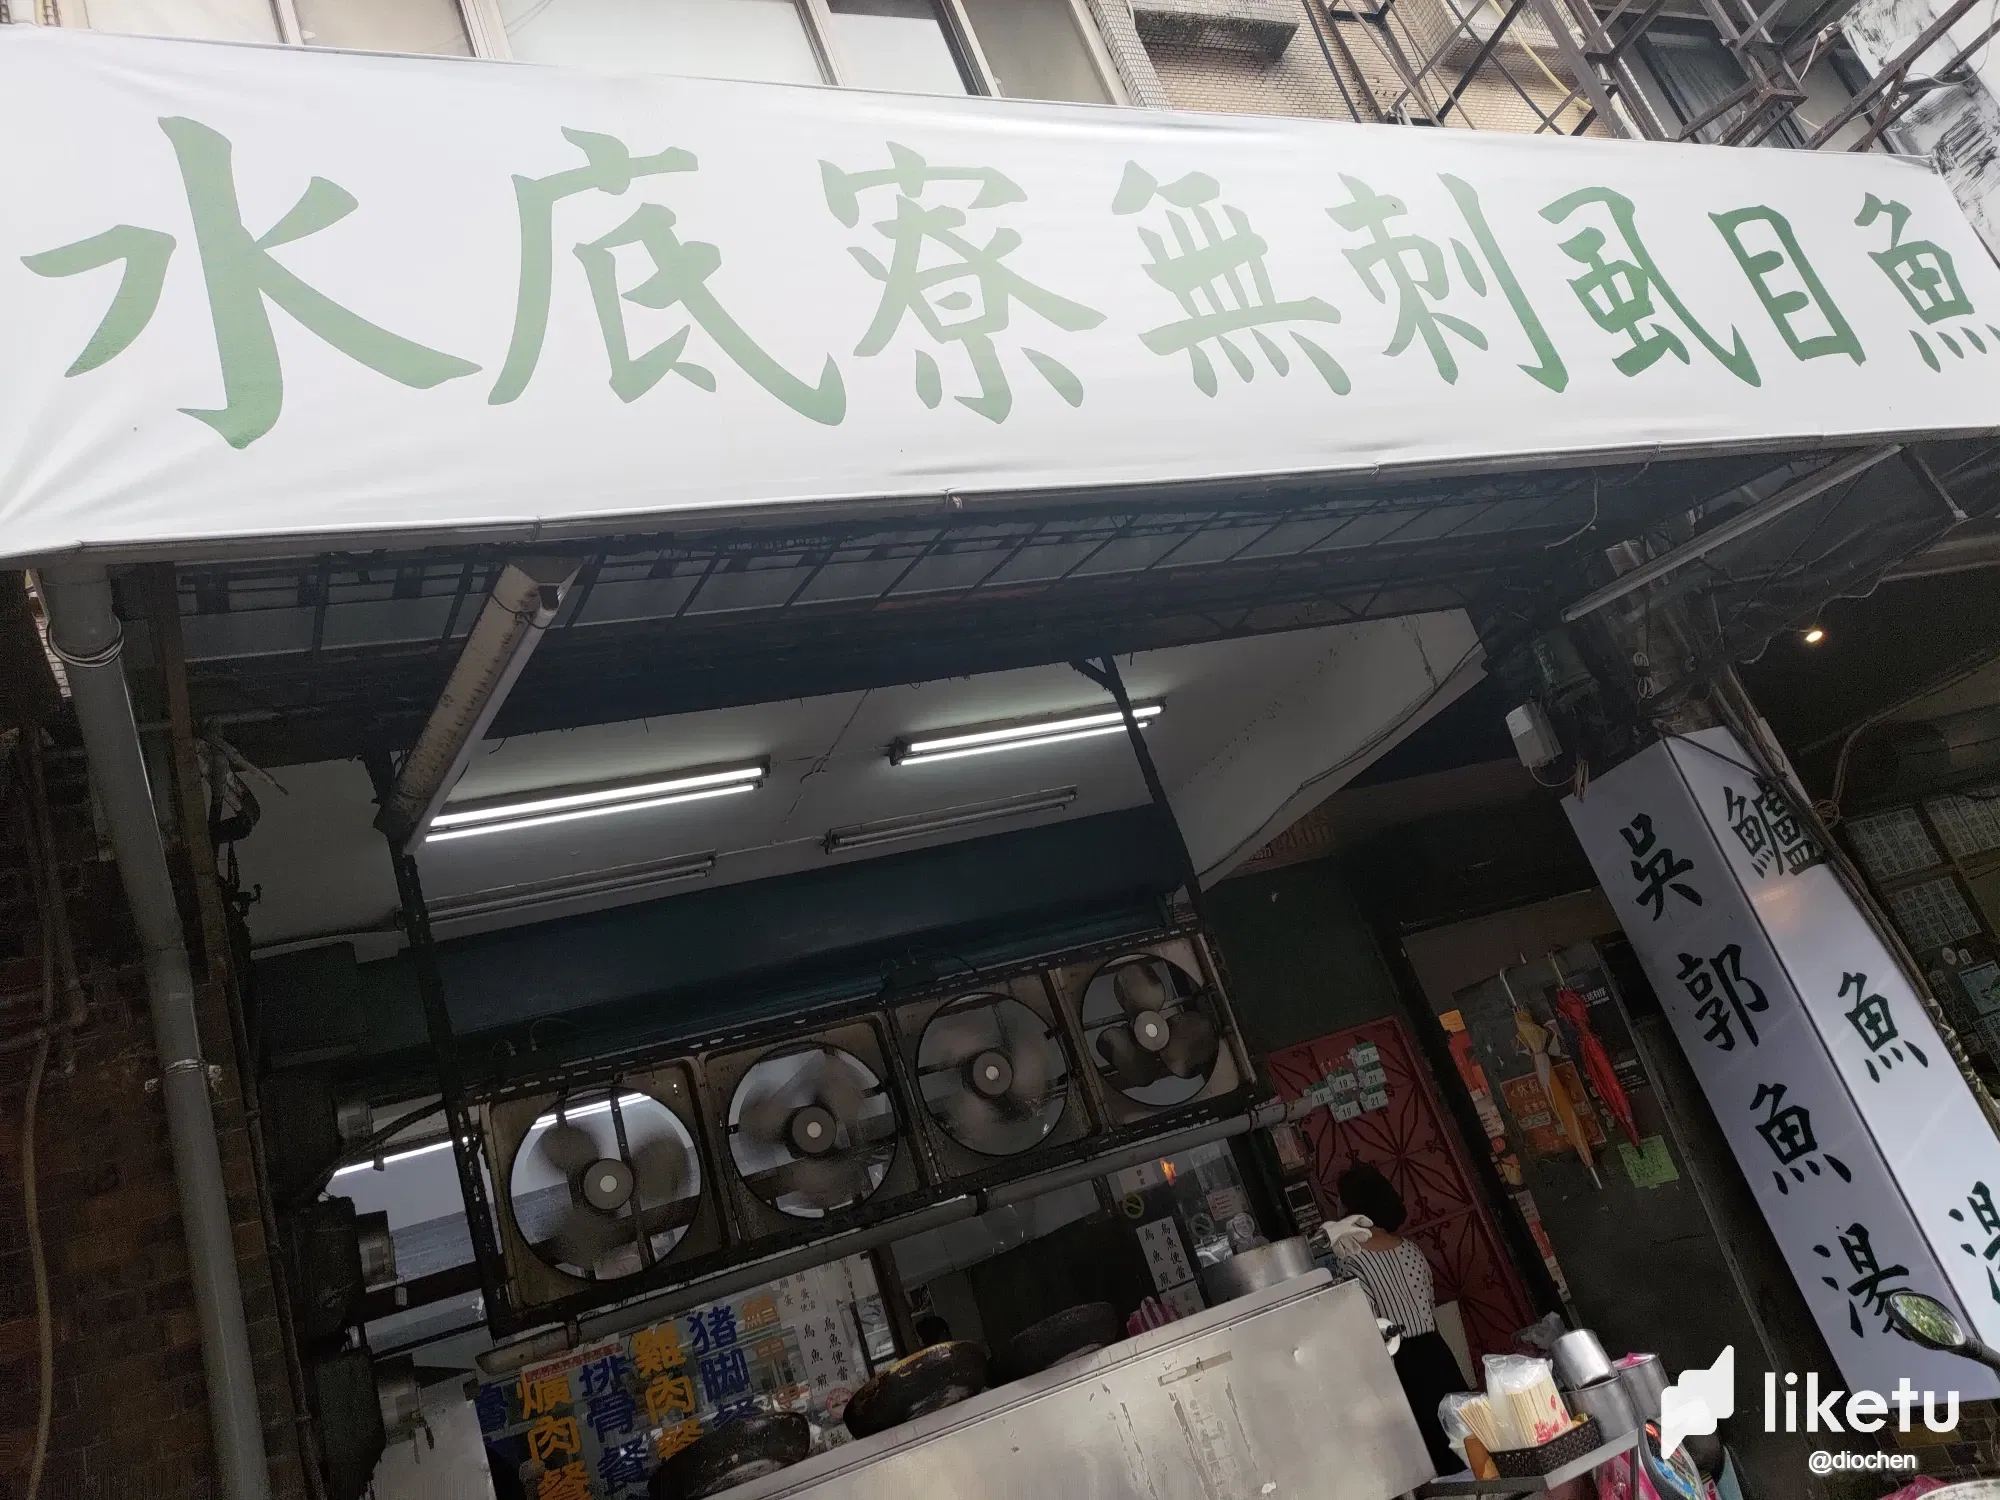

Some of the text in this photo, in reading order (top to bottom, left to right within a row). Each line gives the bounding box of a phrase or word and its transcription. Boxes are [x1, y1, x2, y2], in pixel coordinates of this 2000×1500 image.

[20, 115, 2000, 450] 水底寮無刺虱目魚
[1619, 812, 1914, 1340] 吳郭魚湯
